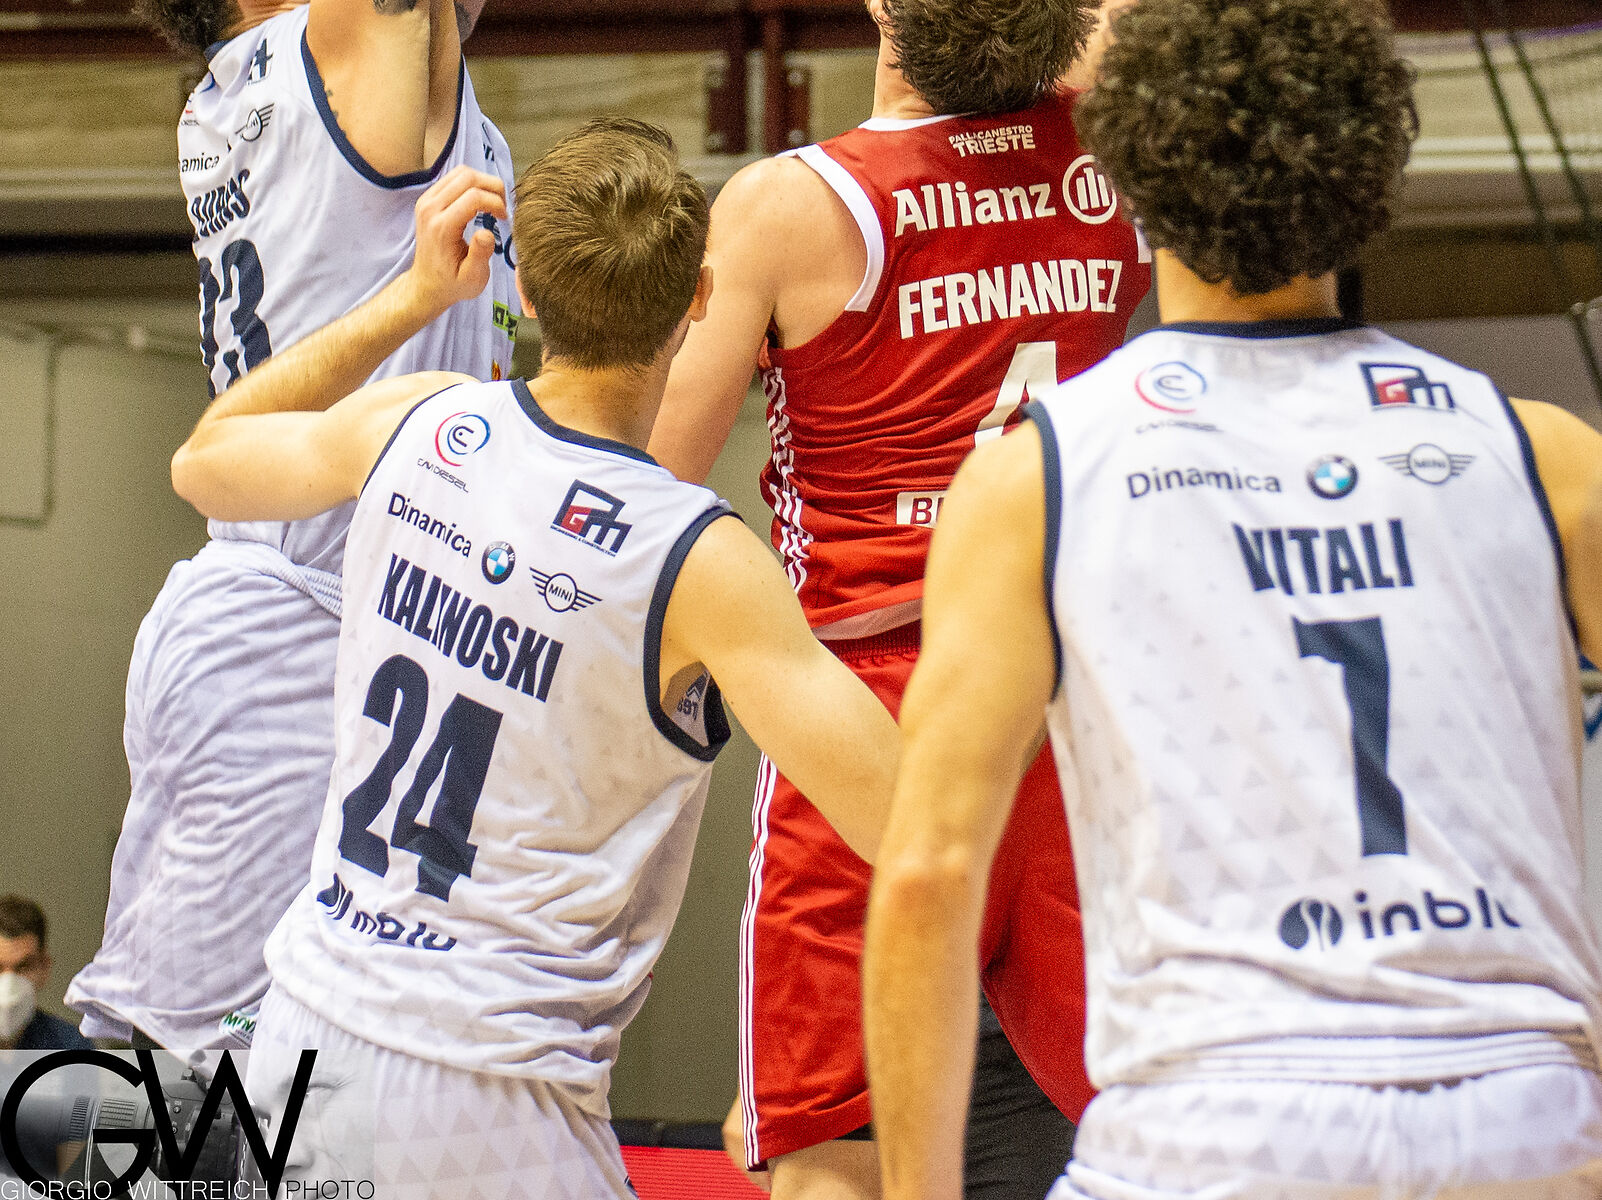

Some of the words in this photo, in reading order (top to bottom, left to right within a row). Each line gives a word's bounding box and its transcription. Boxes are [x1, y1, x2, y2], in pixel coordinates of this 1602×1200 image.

[952, 133, 1036, 158] TRIESTE
[892, 180, 1056, 238] Allianz
[898, 259, 1123, 340] FERNANDEZ
[1127, 466, 1282, 499] Dinamica
[387, 492, 472, 558] Dinamica
[548, 583, 573, 603] MINI
[1231, 518, 1415, 596] VITALI
[1292, 616, 1408, 857] 7
[338, 654, 504, 902] 24
